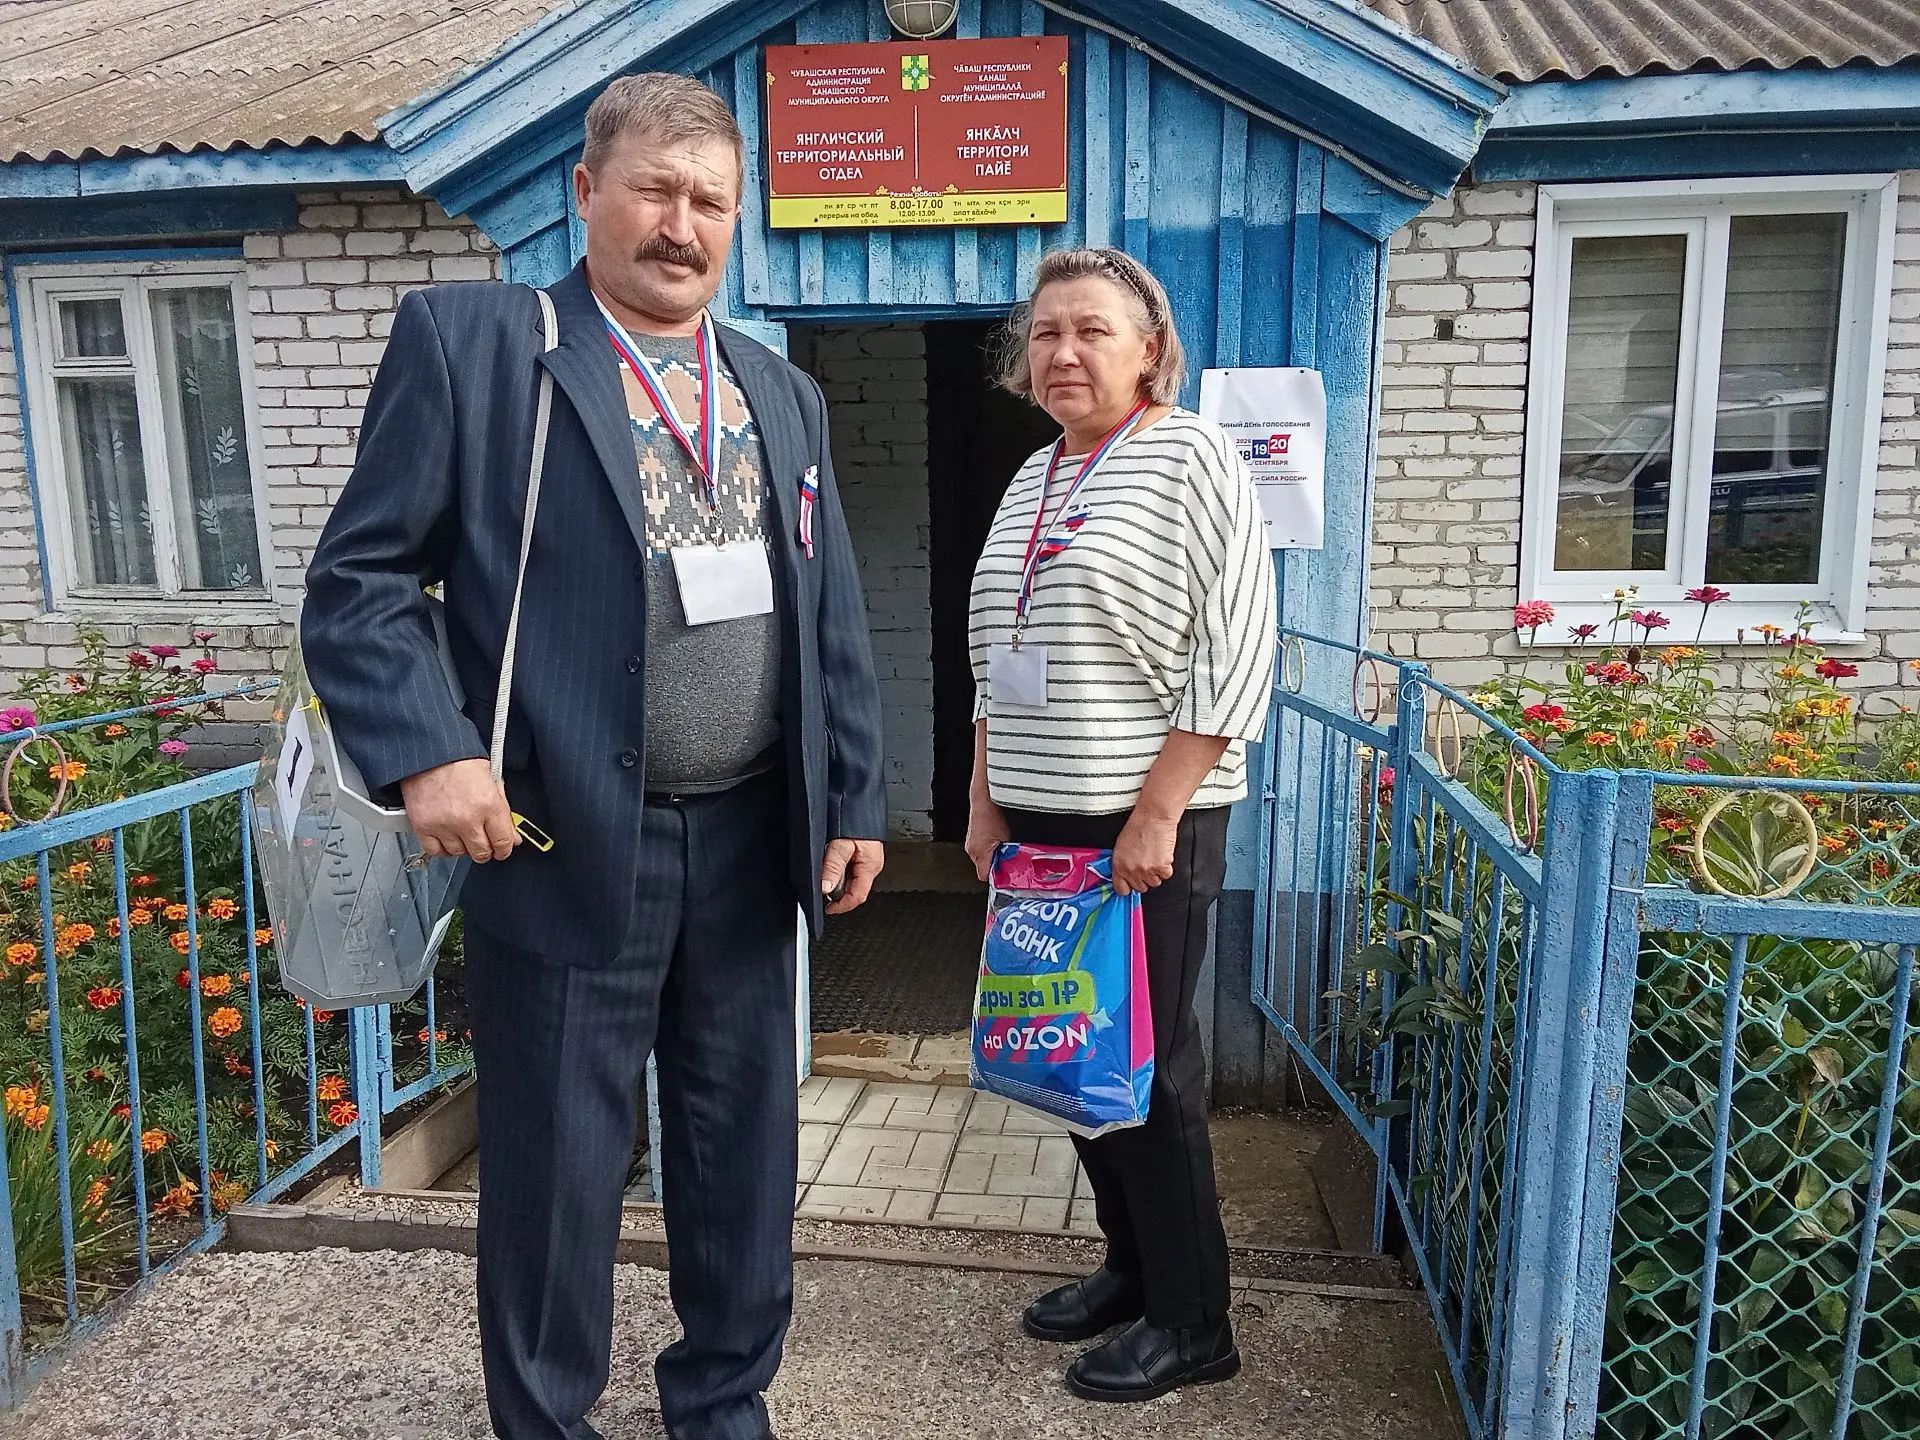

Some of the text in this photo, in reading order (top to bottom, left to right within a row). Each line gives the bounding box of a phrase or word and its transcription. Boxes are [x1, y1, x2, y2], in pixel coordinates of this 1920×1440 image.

[791, 67, 886, 77] ЧУВАШСКАЯ РЕСПУБЛИКА
[983, 63, 1031, 72] РЕСПУБЛИКИ
[806, 77, 871, 86] АДМИНИСТРАЦИЯ
[979, 73, 1006, 82] КАНАШ
[812, 87, 865, 96] КАНАШСКОГО
[788, 96, 890, 106] МУНИЦИПАЛЬНОГО ОКРУГА
[796, 129, 884, 146] ЯНГЛИЧСКИЙ
[776, 146, 904, 163] ТЕРРИТОРИАЛЬНЫЙ
[957, 145, 1029, 159] ТЕРРИТОРИ
[819, 167, 863, 181] ОТДЕЛ
[890, 199, 943, 210] 8.00-17.00
[1254, 443, 1268, 455] 19
[1270, 439, 1287, 450] 20
[1000, 910, 1065, 963] банк
[1018, 988, 1044, 1008] за
[984, 1023, 1088, 1050] на OZON
